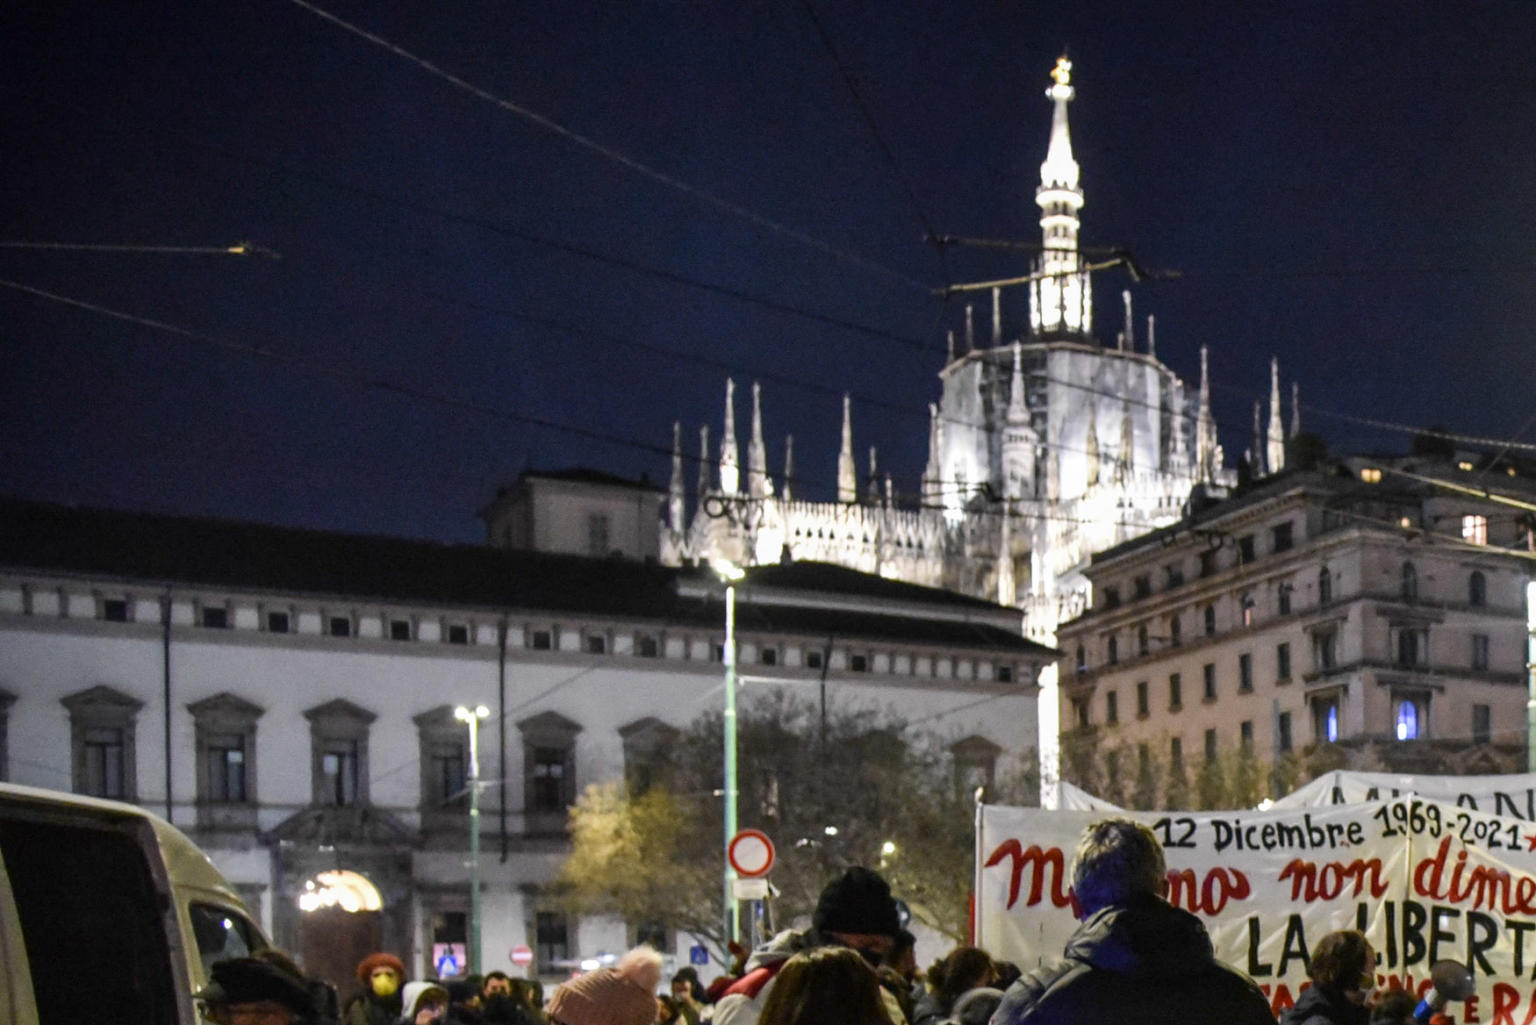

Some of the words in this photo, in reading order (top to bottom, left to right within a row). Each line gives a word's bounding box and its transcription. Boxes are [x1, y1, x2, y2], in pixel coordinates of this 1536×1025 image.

[1152, 817, 1197, 848] 12
[1210, 804, 1365, 852] Dicembre
[1277, 857, 1390, 904] non
[1248, 913, 1313, 978] LA
